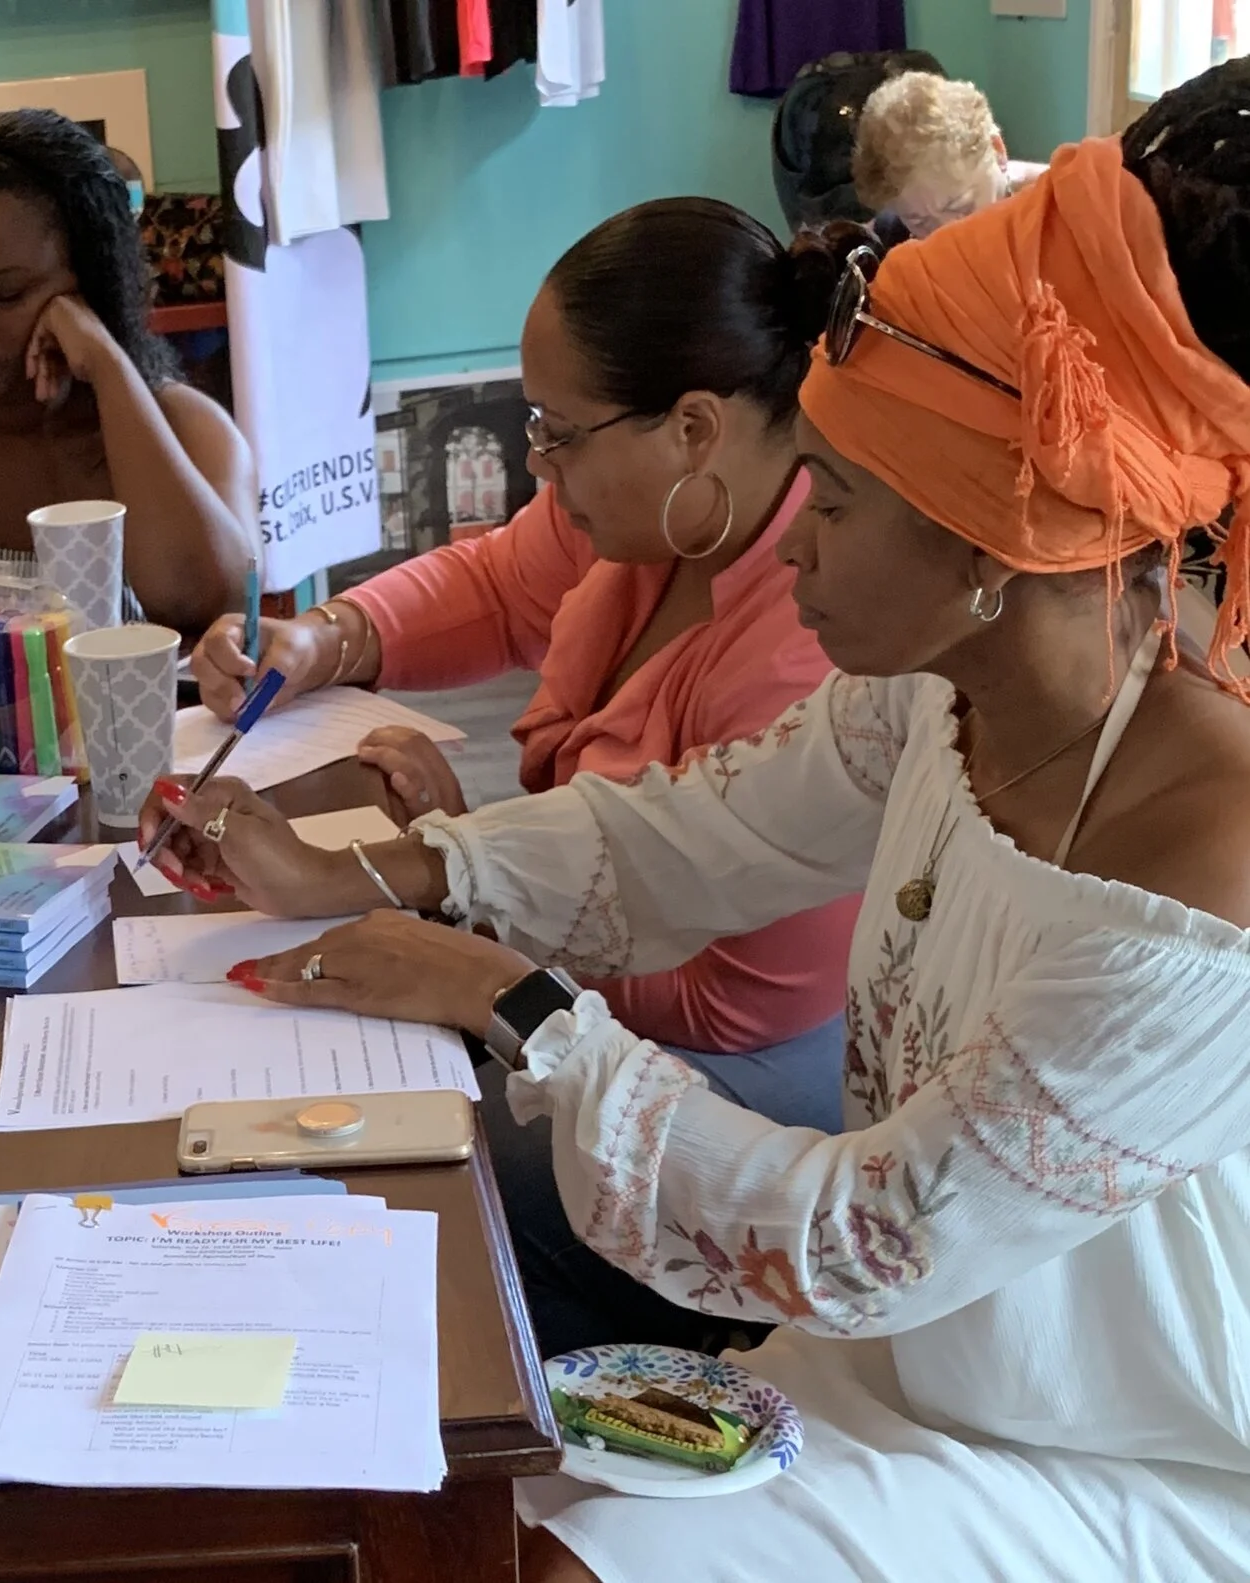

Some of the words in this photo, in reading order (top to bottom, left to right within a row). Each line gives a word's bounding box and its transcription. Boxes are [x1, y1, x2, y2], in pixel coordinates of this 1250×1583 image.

[167, 1229, 232, 1237] Workshop
[235, 1229, 283, 1237] Outline
[106, 1235, 149, 1243] TOPIC:
[152, 1235, 172, 1244] I'M
[311, 1239, 341, 1247] LIFE!
